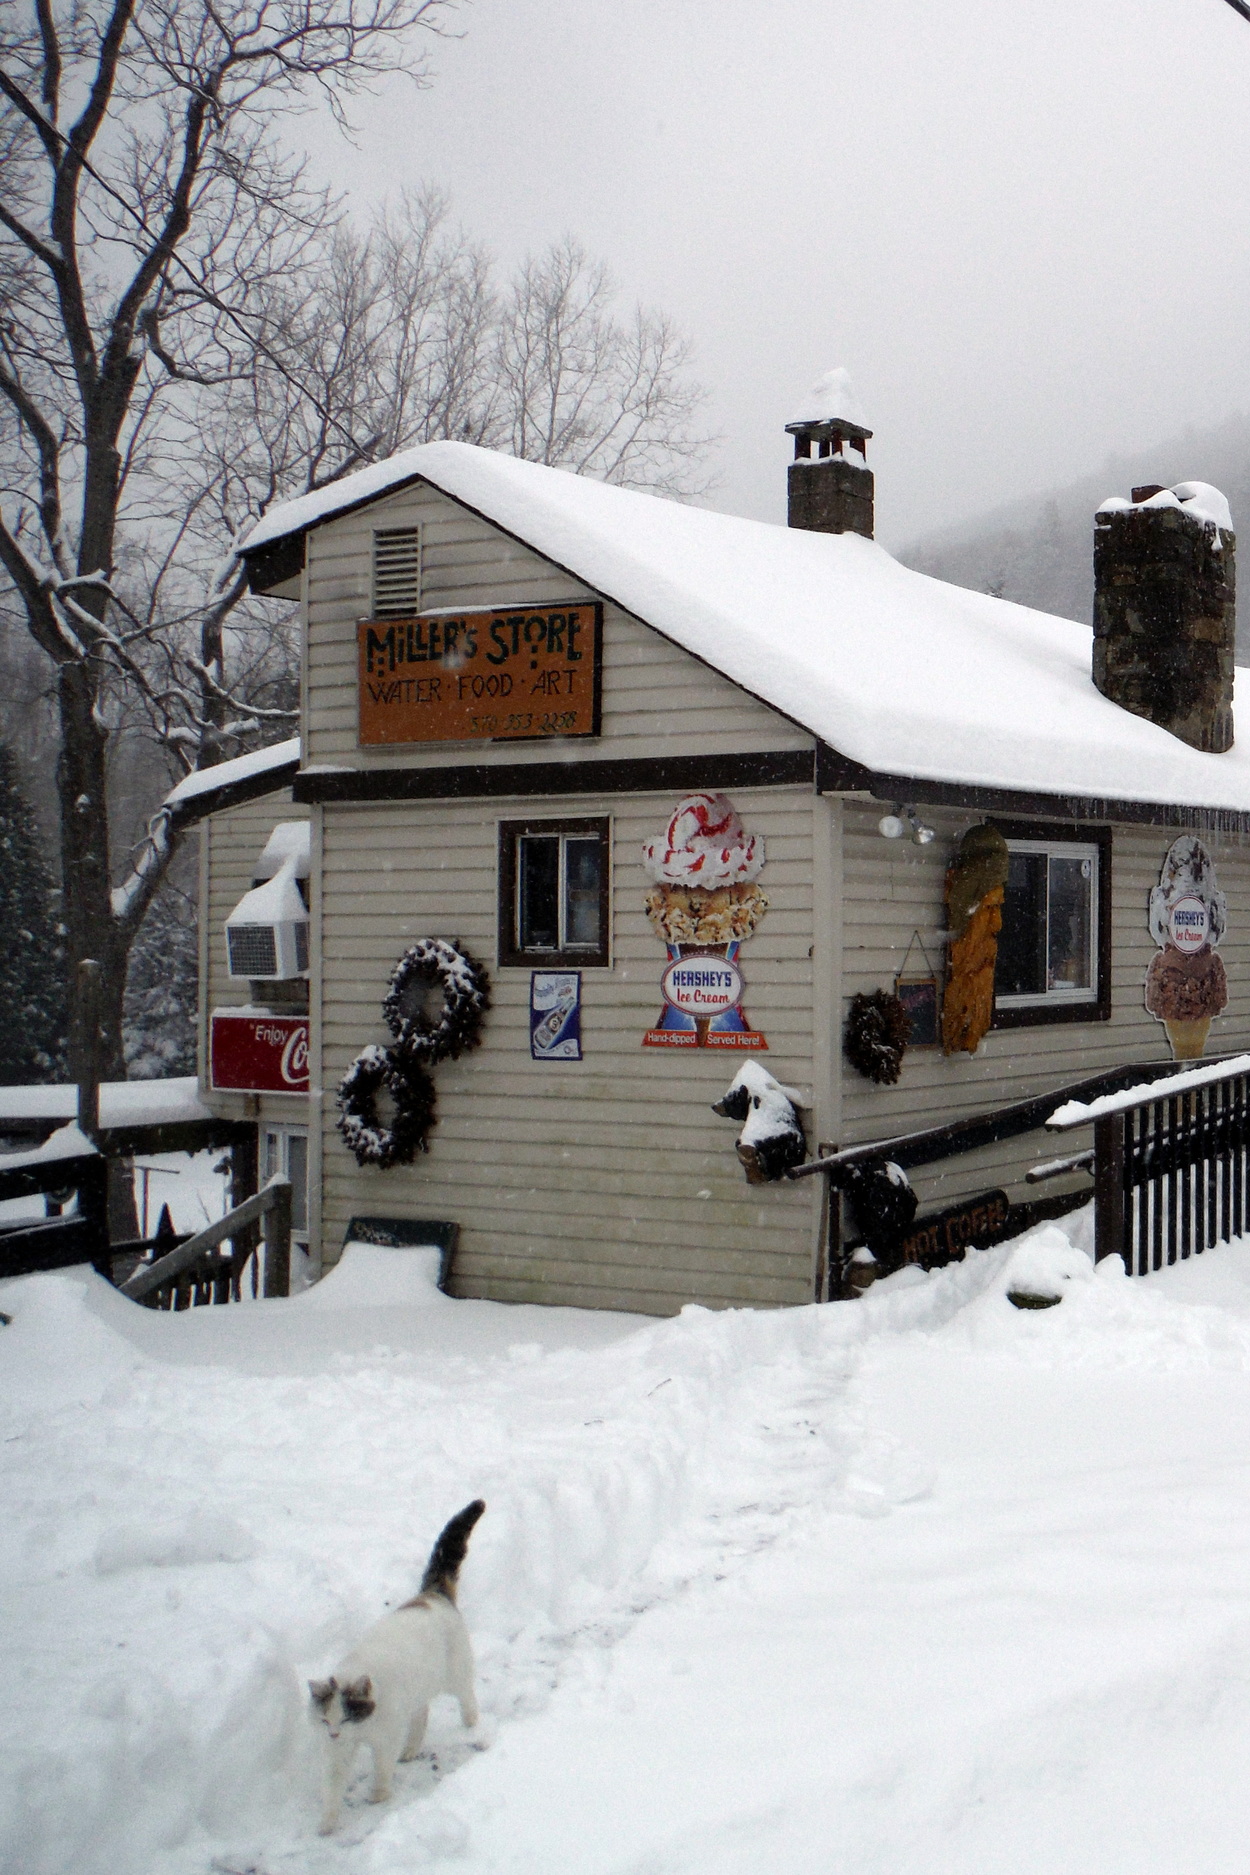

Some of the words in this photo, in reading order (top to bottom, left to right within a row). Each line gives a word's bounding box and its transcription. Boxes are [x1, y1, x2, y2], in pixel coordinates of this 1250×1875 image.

[485, 612, 582, 668] STORE
[366, 679, 442, 704] WATER
[458, 673, 513, 700] FOOD
[530, 669, 578, 695] ART
[1174, 910, 1204, 926] HERSHEY'S
[672, 970, 732, 987] HERSHEY'S
[676, 988, 692, 1003] Ice
[694, 988, 730, 1003] Cream
[255, 1025, 288, 1046] Enjoy
[647, 1031, 696, 1045] Hand-dipped
[707, 1033, 736, 1045] Served
[738, 1034, 760, 1046] Here!
[281, 1027, 310, 1084] Co
